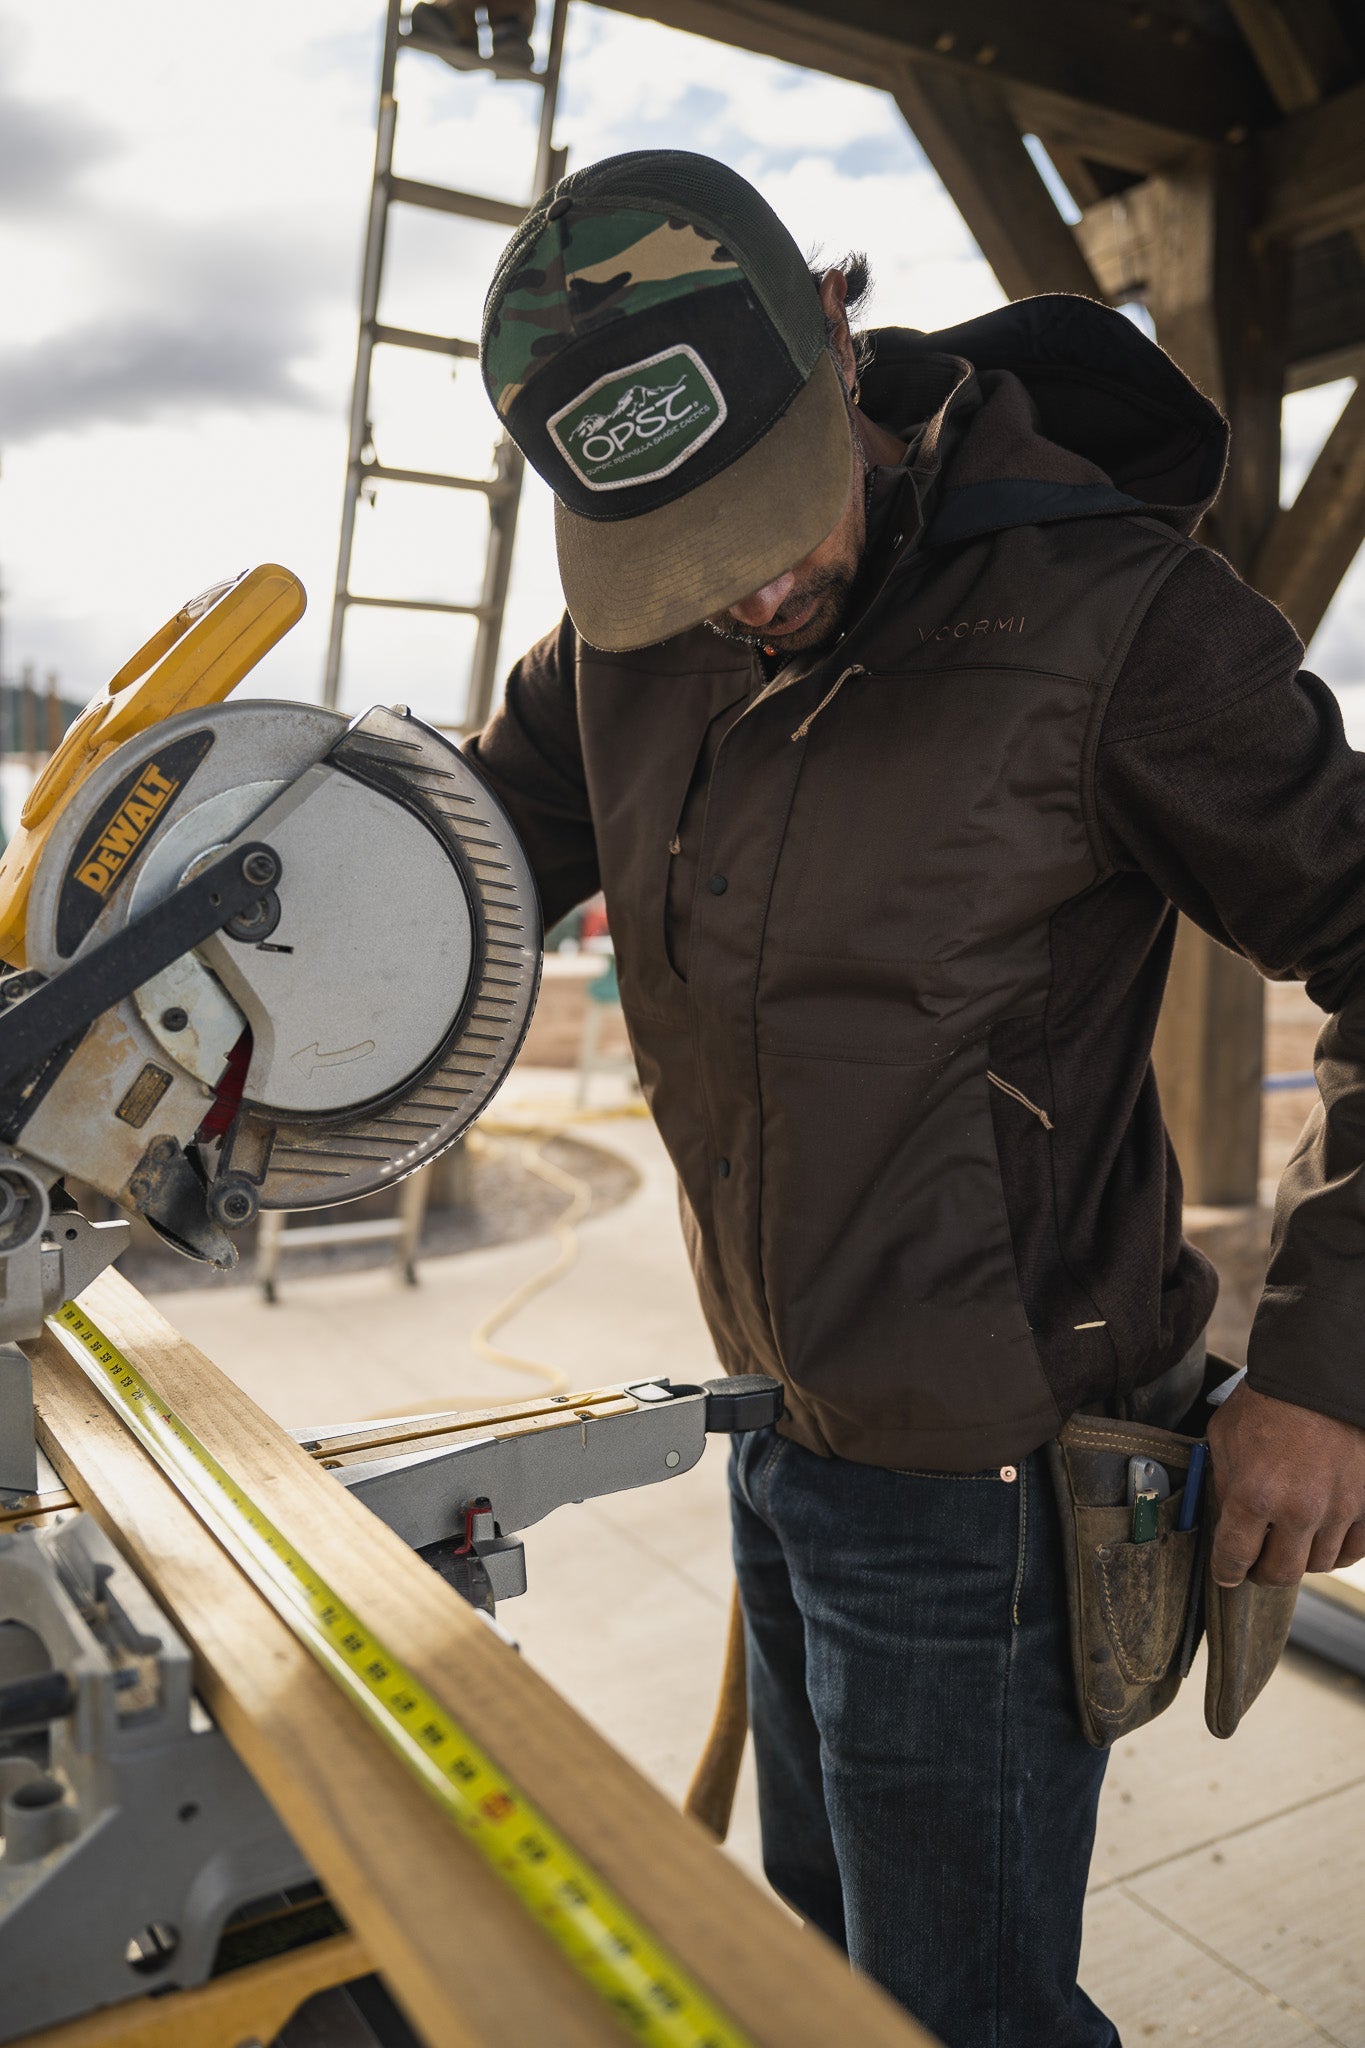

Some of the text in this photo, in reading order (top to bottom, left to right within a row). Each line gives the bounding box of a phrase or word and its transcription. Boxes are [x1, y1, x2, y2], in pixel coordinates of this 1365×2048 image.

[81, 1331, 93, 1340] 87
[100, 1352, 112, 1363] 85
[110, 1364, 122, 1375] 84
[120, 1376, 133, 1387] 83
